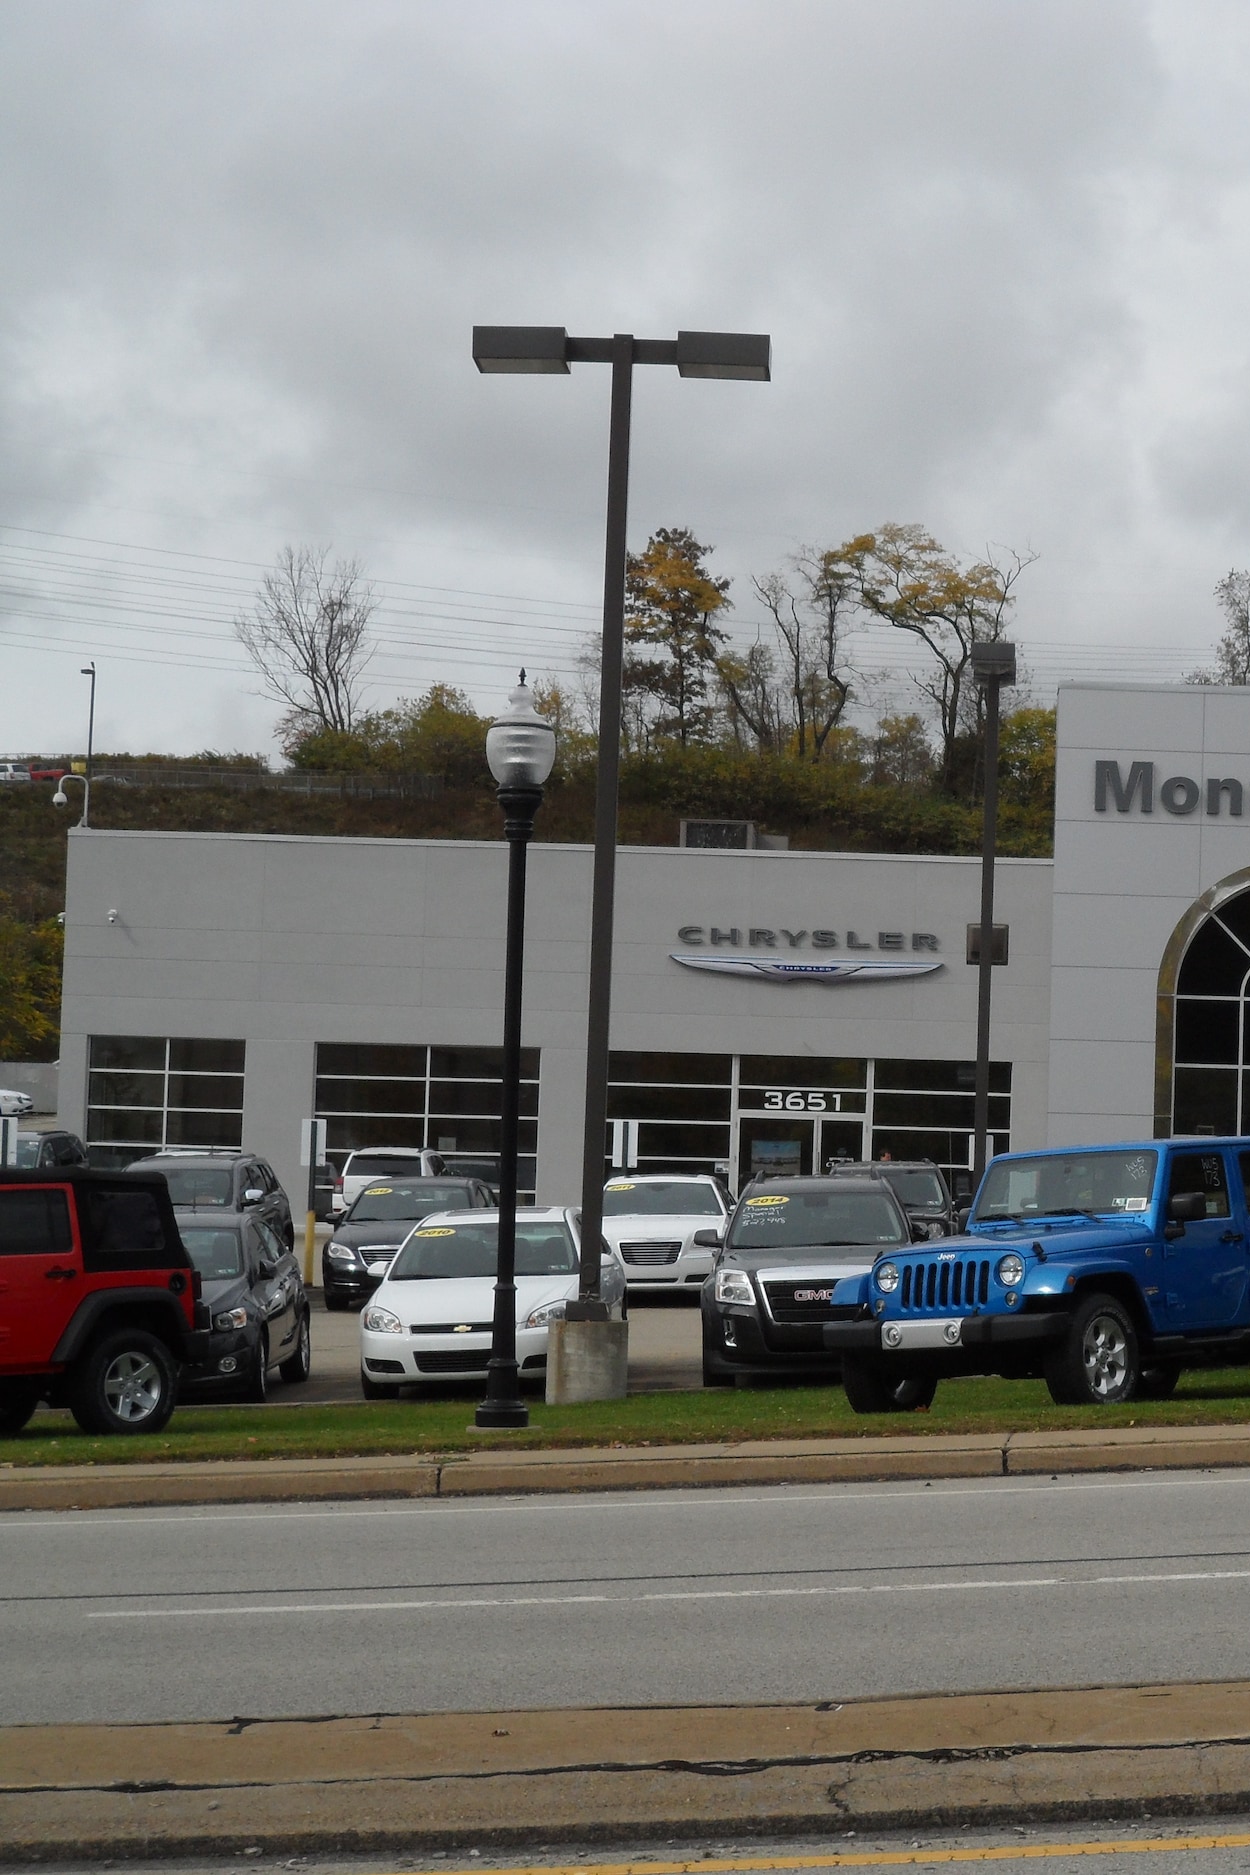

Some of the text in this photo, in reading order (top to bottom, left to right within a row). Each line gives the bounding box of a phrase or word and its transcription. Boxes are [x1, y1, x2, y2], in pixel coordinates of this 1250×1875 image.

[677, 926, 940, 951] CHRYSLER
[763, 1091, 842, 1112] 3651
[937, 1253, 956, 1261] Jeep
